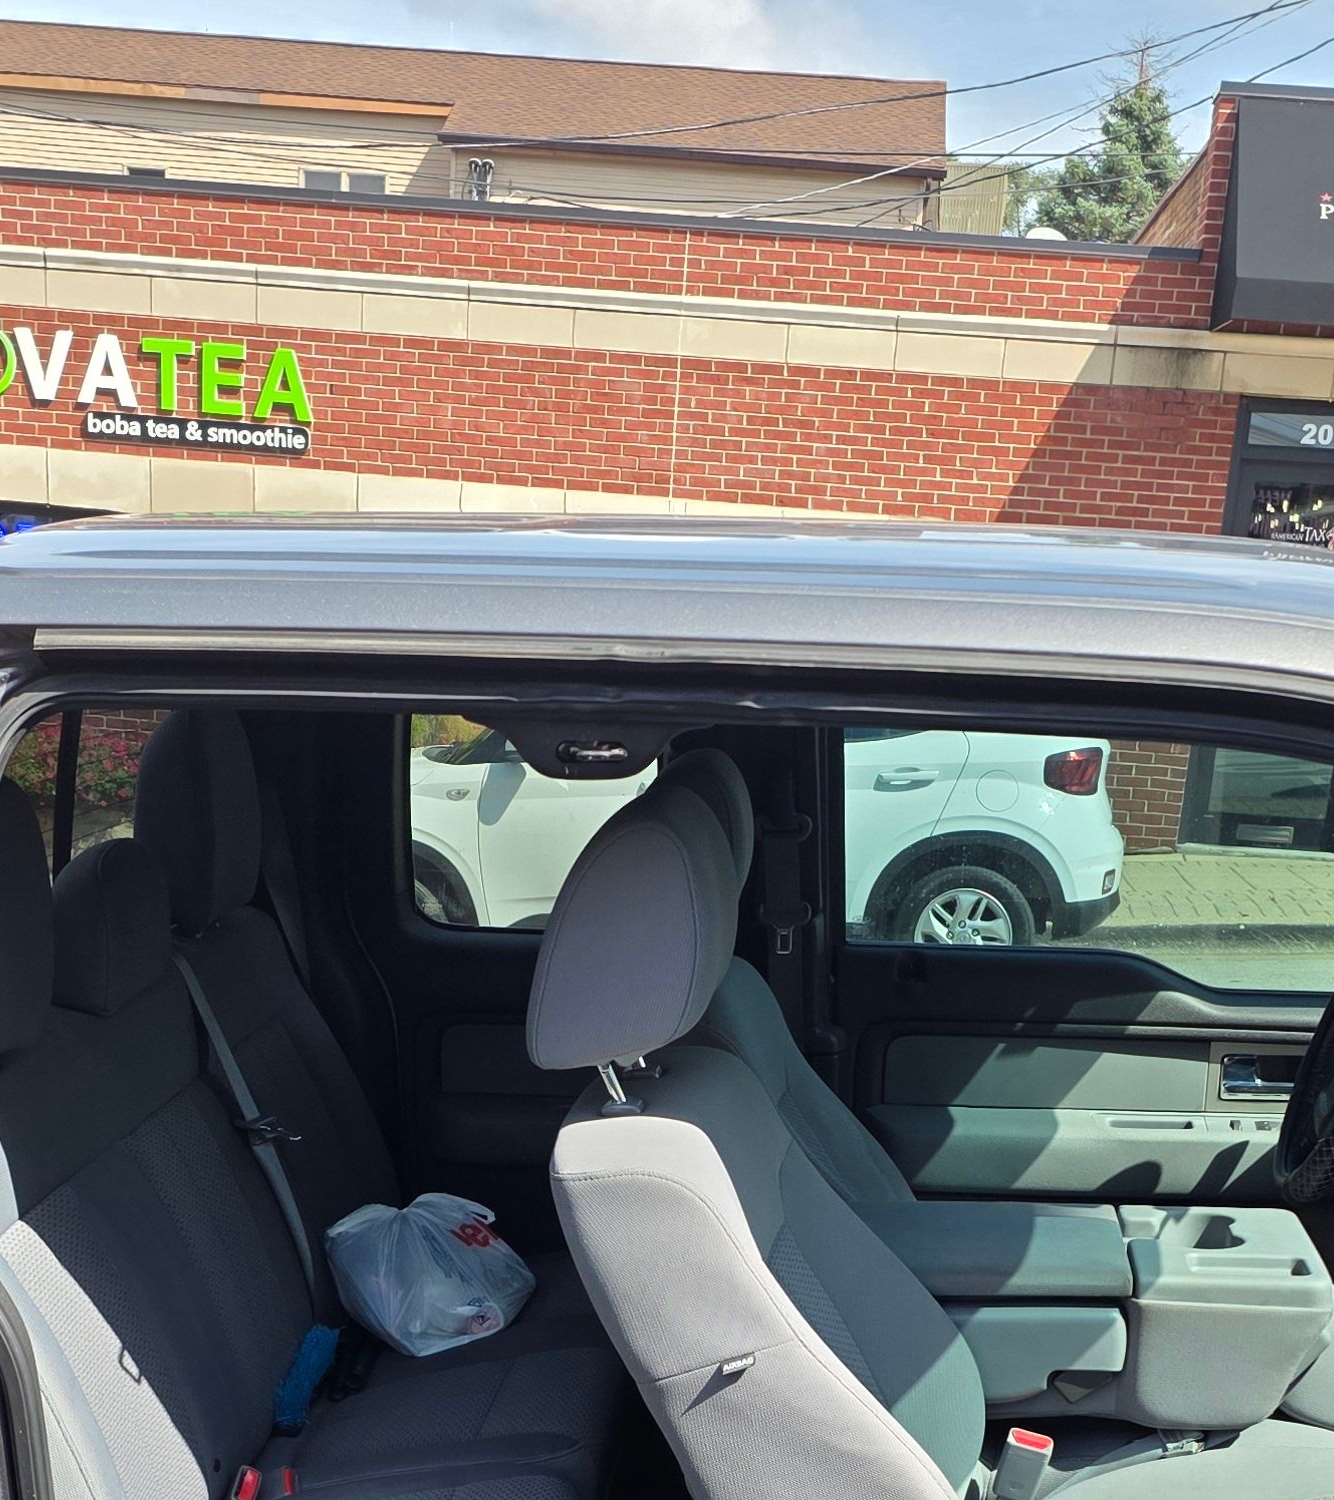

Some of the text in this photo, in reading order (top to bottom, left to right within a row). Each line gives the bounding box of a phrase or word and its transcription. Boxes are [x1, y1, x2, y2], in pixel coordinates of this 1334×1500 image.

[88, 413, 306, 450] boba tea & smoothie
